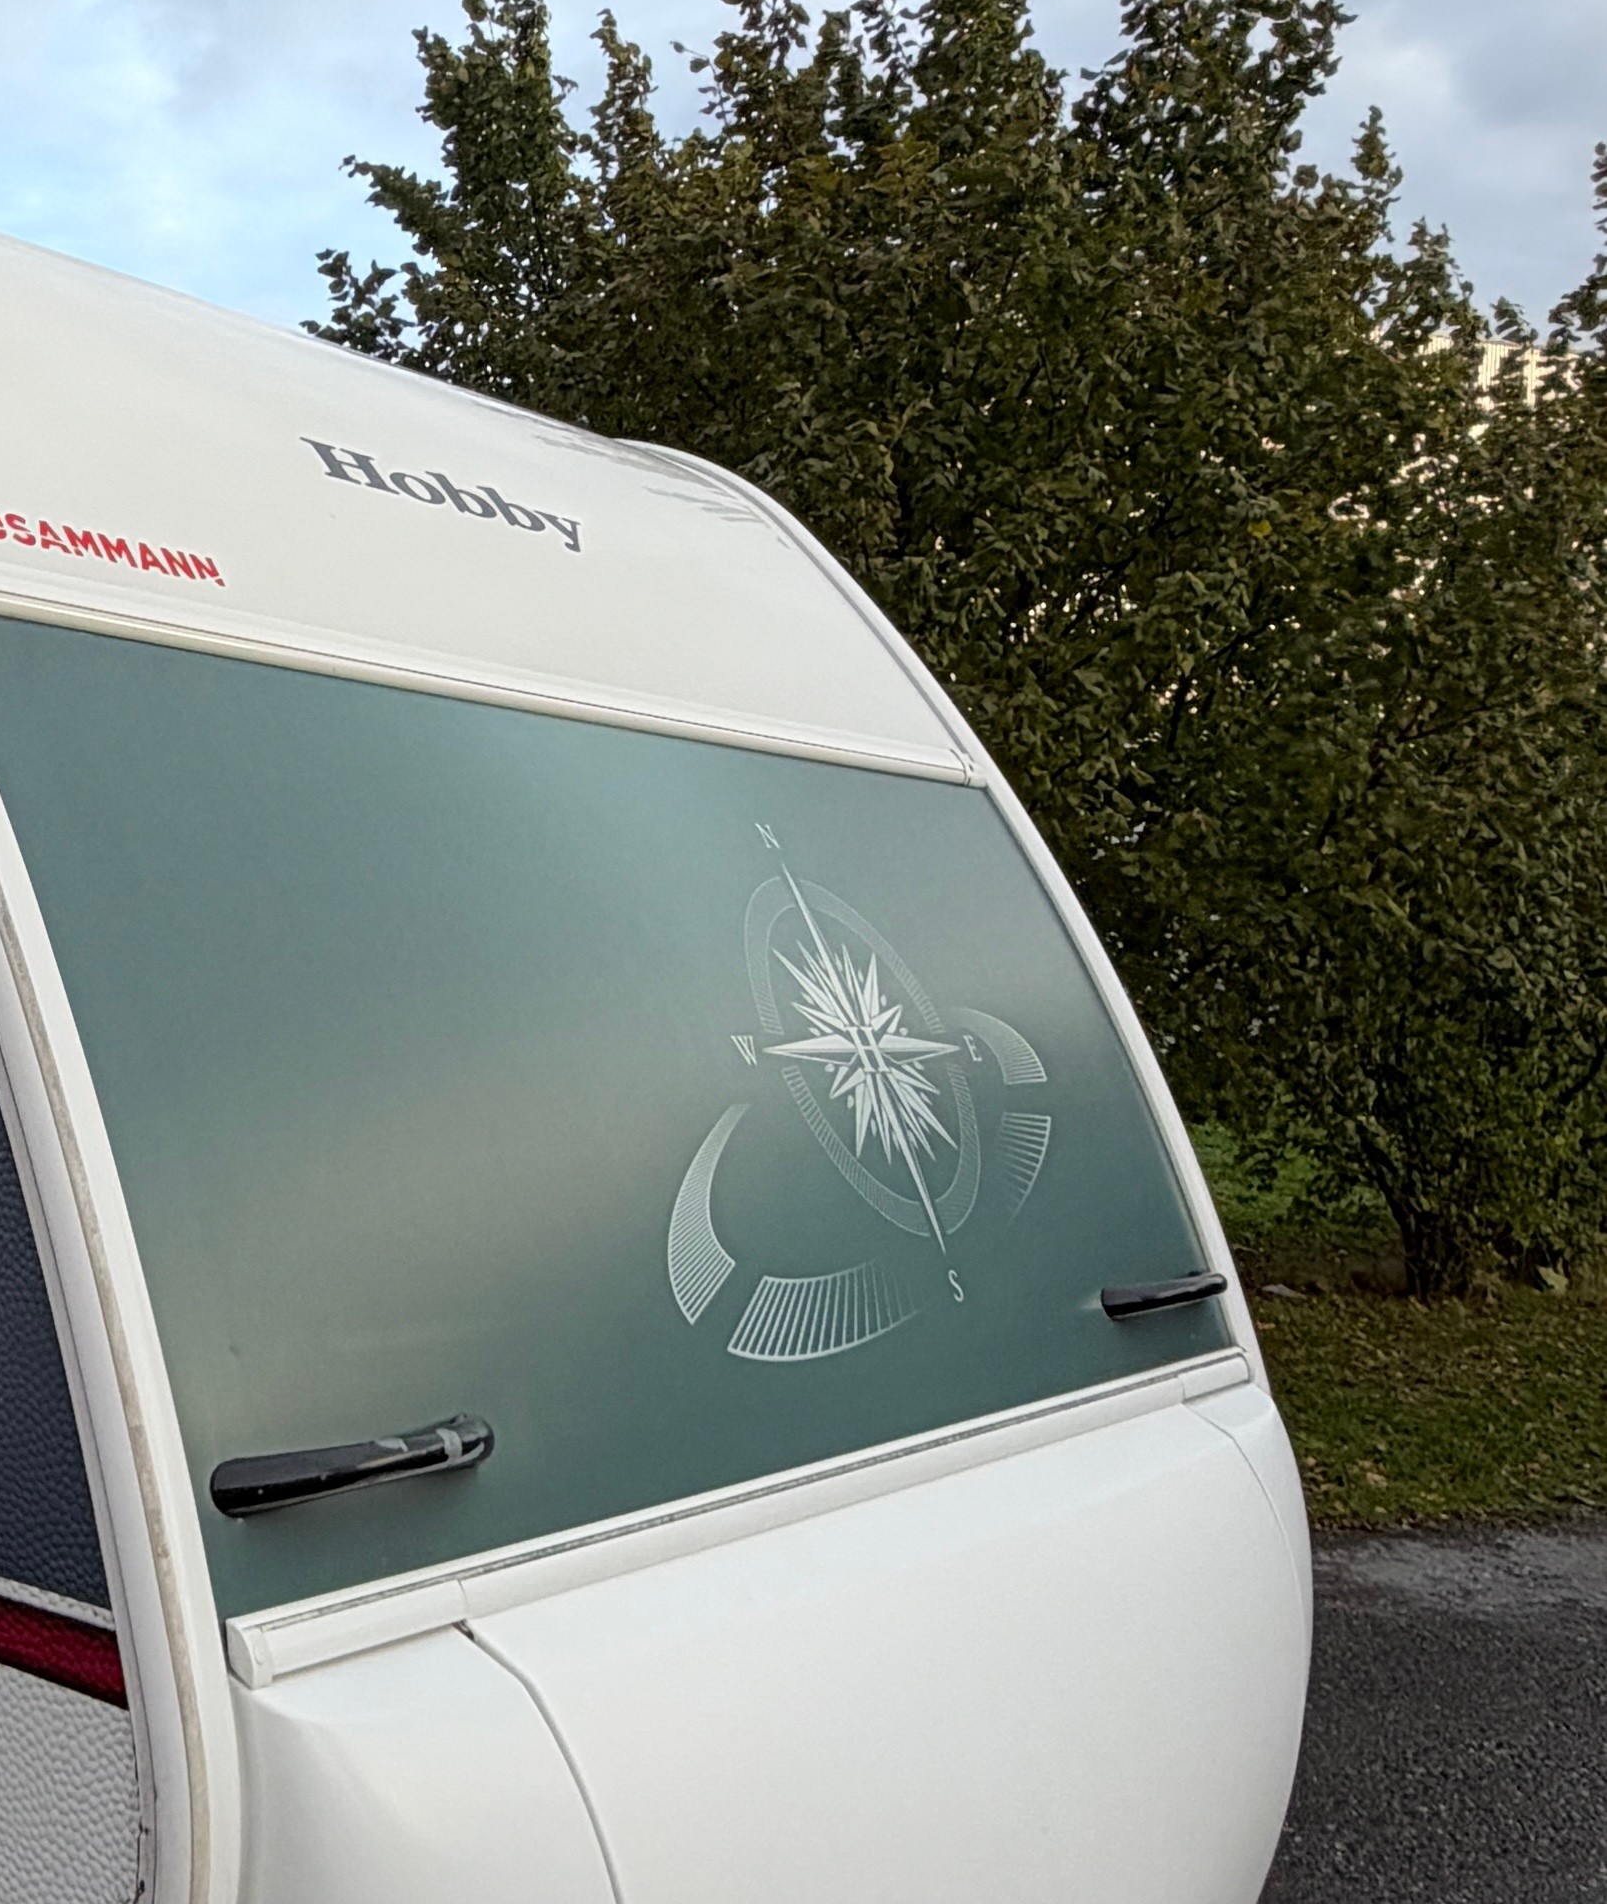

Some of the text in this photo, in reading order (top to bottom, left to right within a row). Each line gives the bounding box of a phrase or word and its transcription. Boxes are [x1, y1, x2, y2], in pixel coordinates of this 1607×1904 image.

[299, 436, 584, 553] Hobby
[754, 822, 781, 851] N
[730, 1034, 758, 1066] W
[963, 1035, 984, 1063] E
[945, 1269, 965, 1303] S
